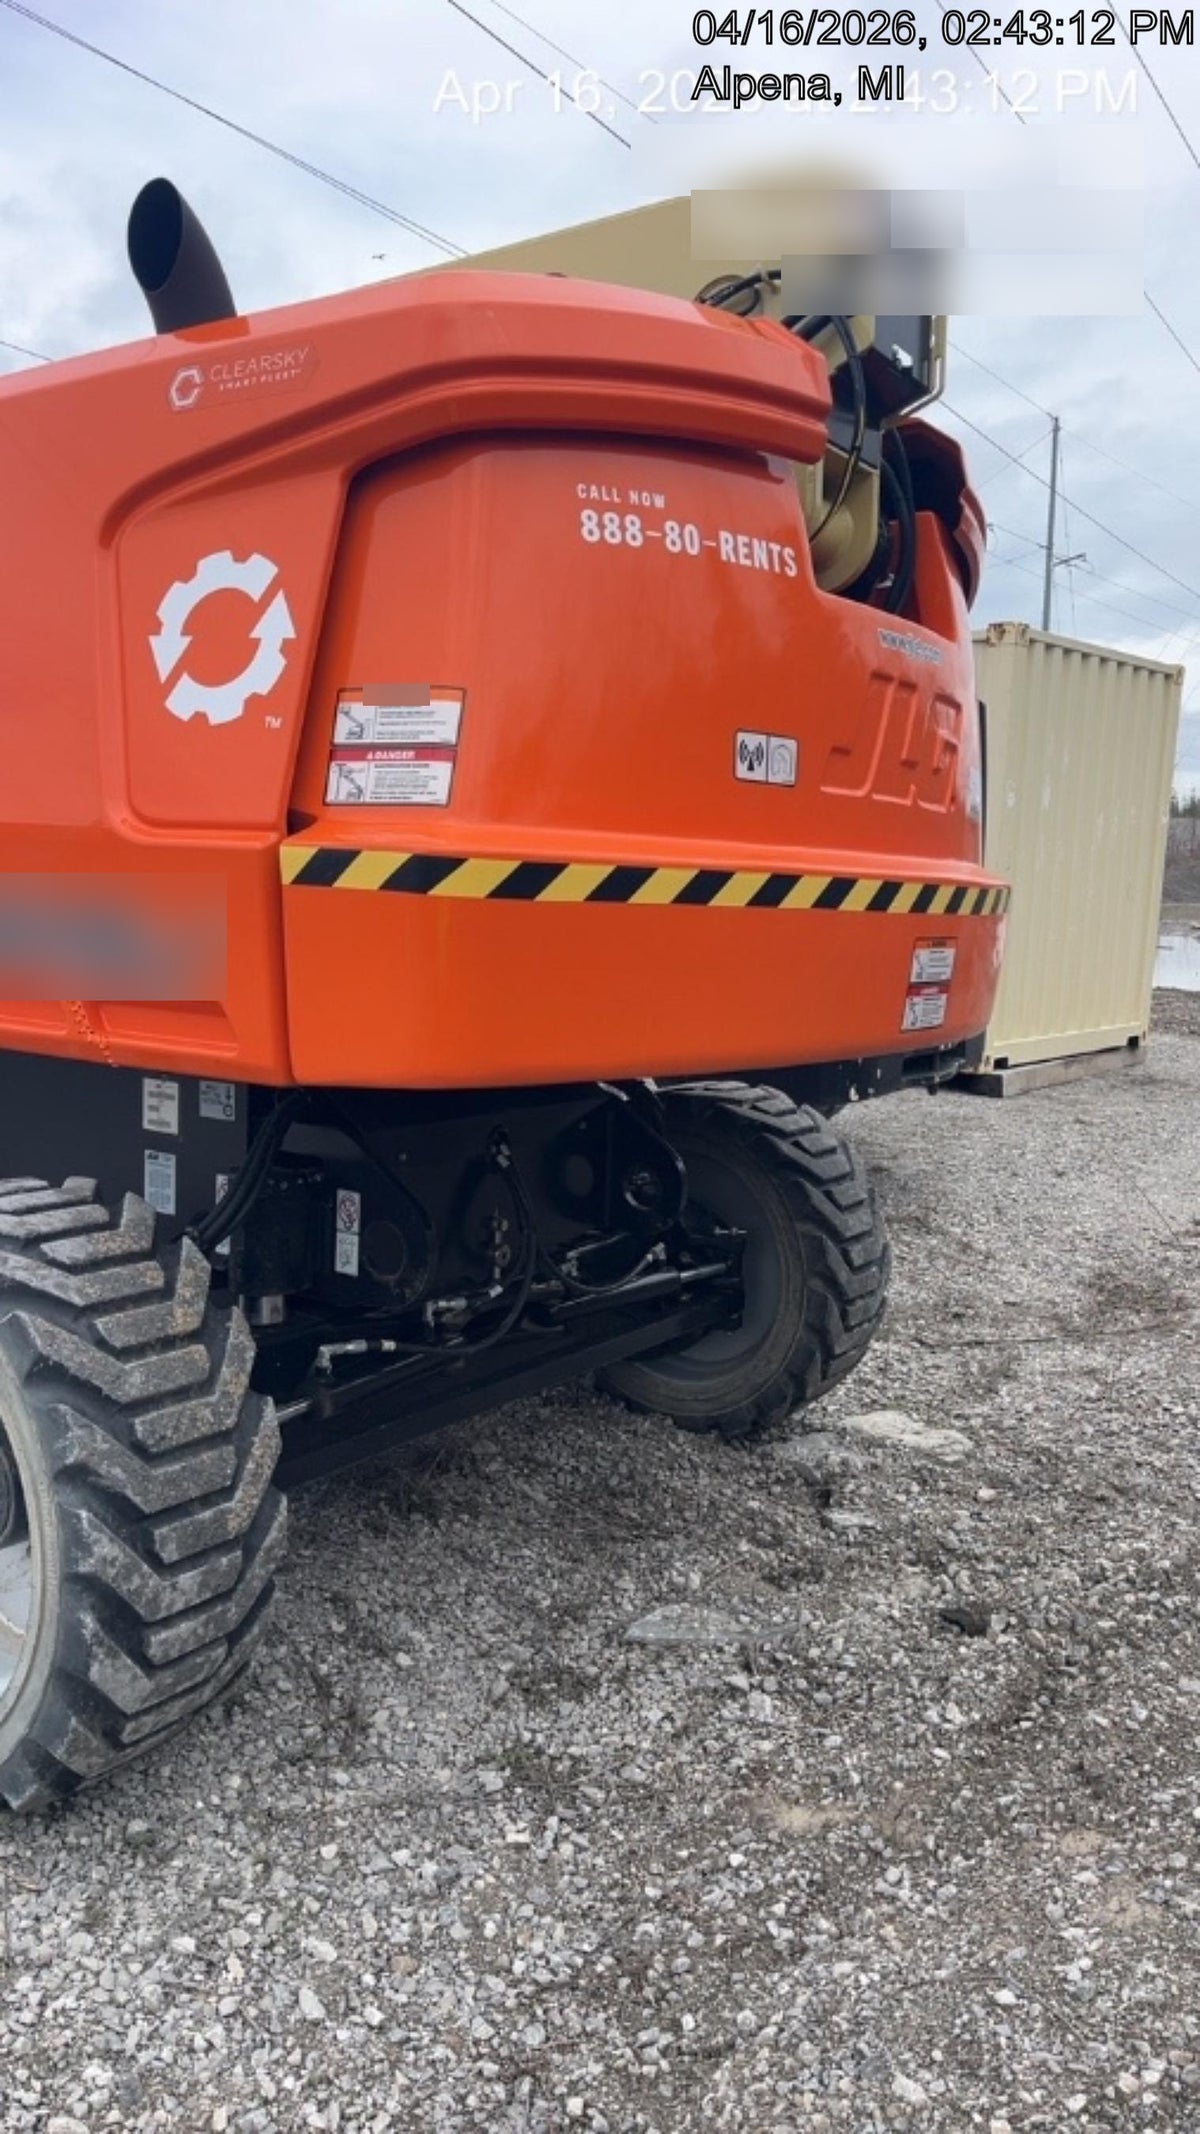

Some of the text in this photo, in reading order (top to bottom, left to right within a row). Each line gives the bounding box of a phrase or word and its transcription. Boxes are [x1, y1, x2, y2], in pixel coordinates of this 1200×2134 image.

[210, 346, 310, 382] CLEARSKY
[576, 483, 666, 508] CALL NOW
[580, 508, 798, 577] 888-80-RENTS
